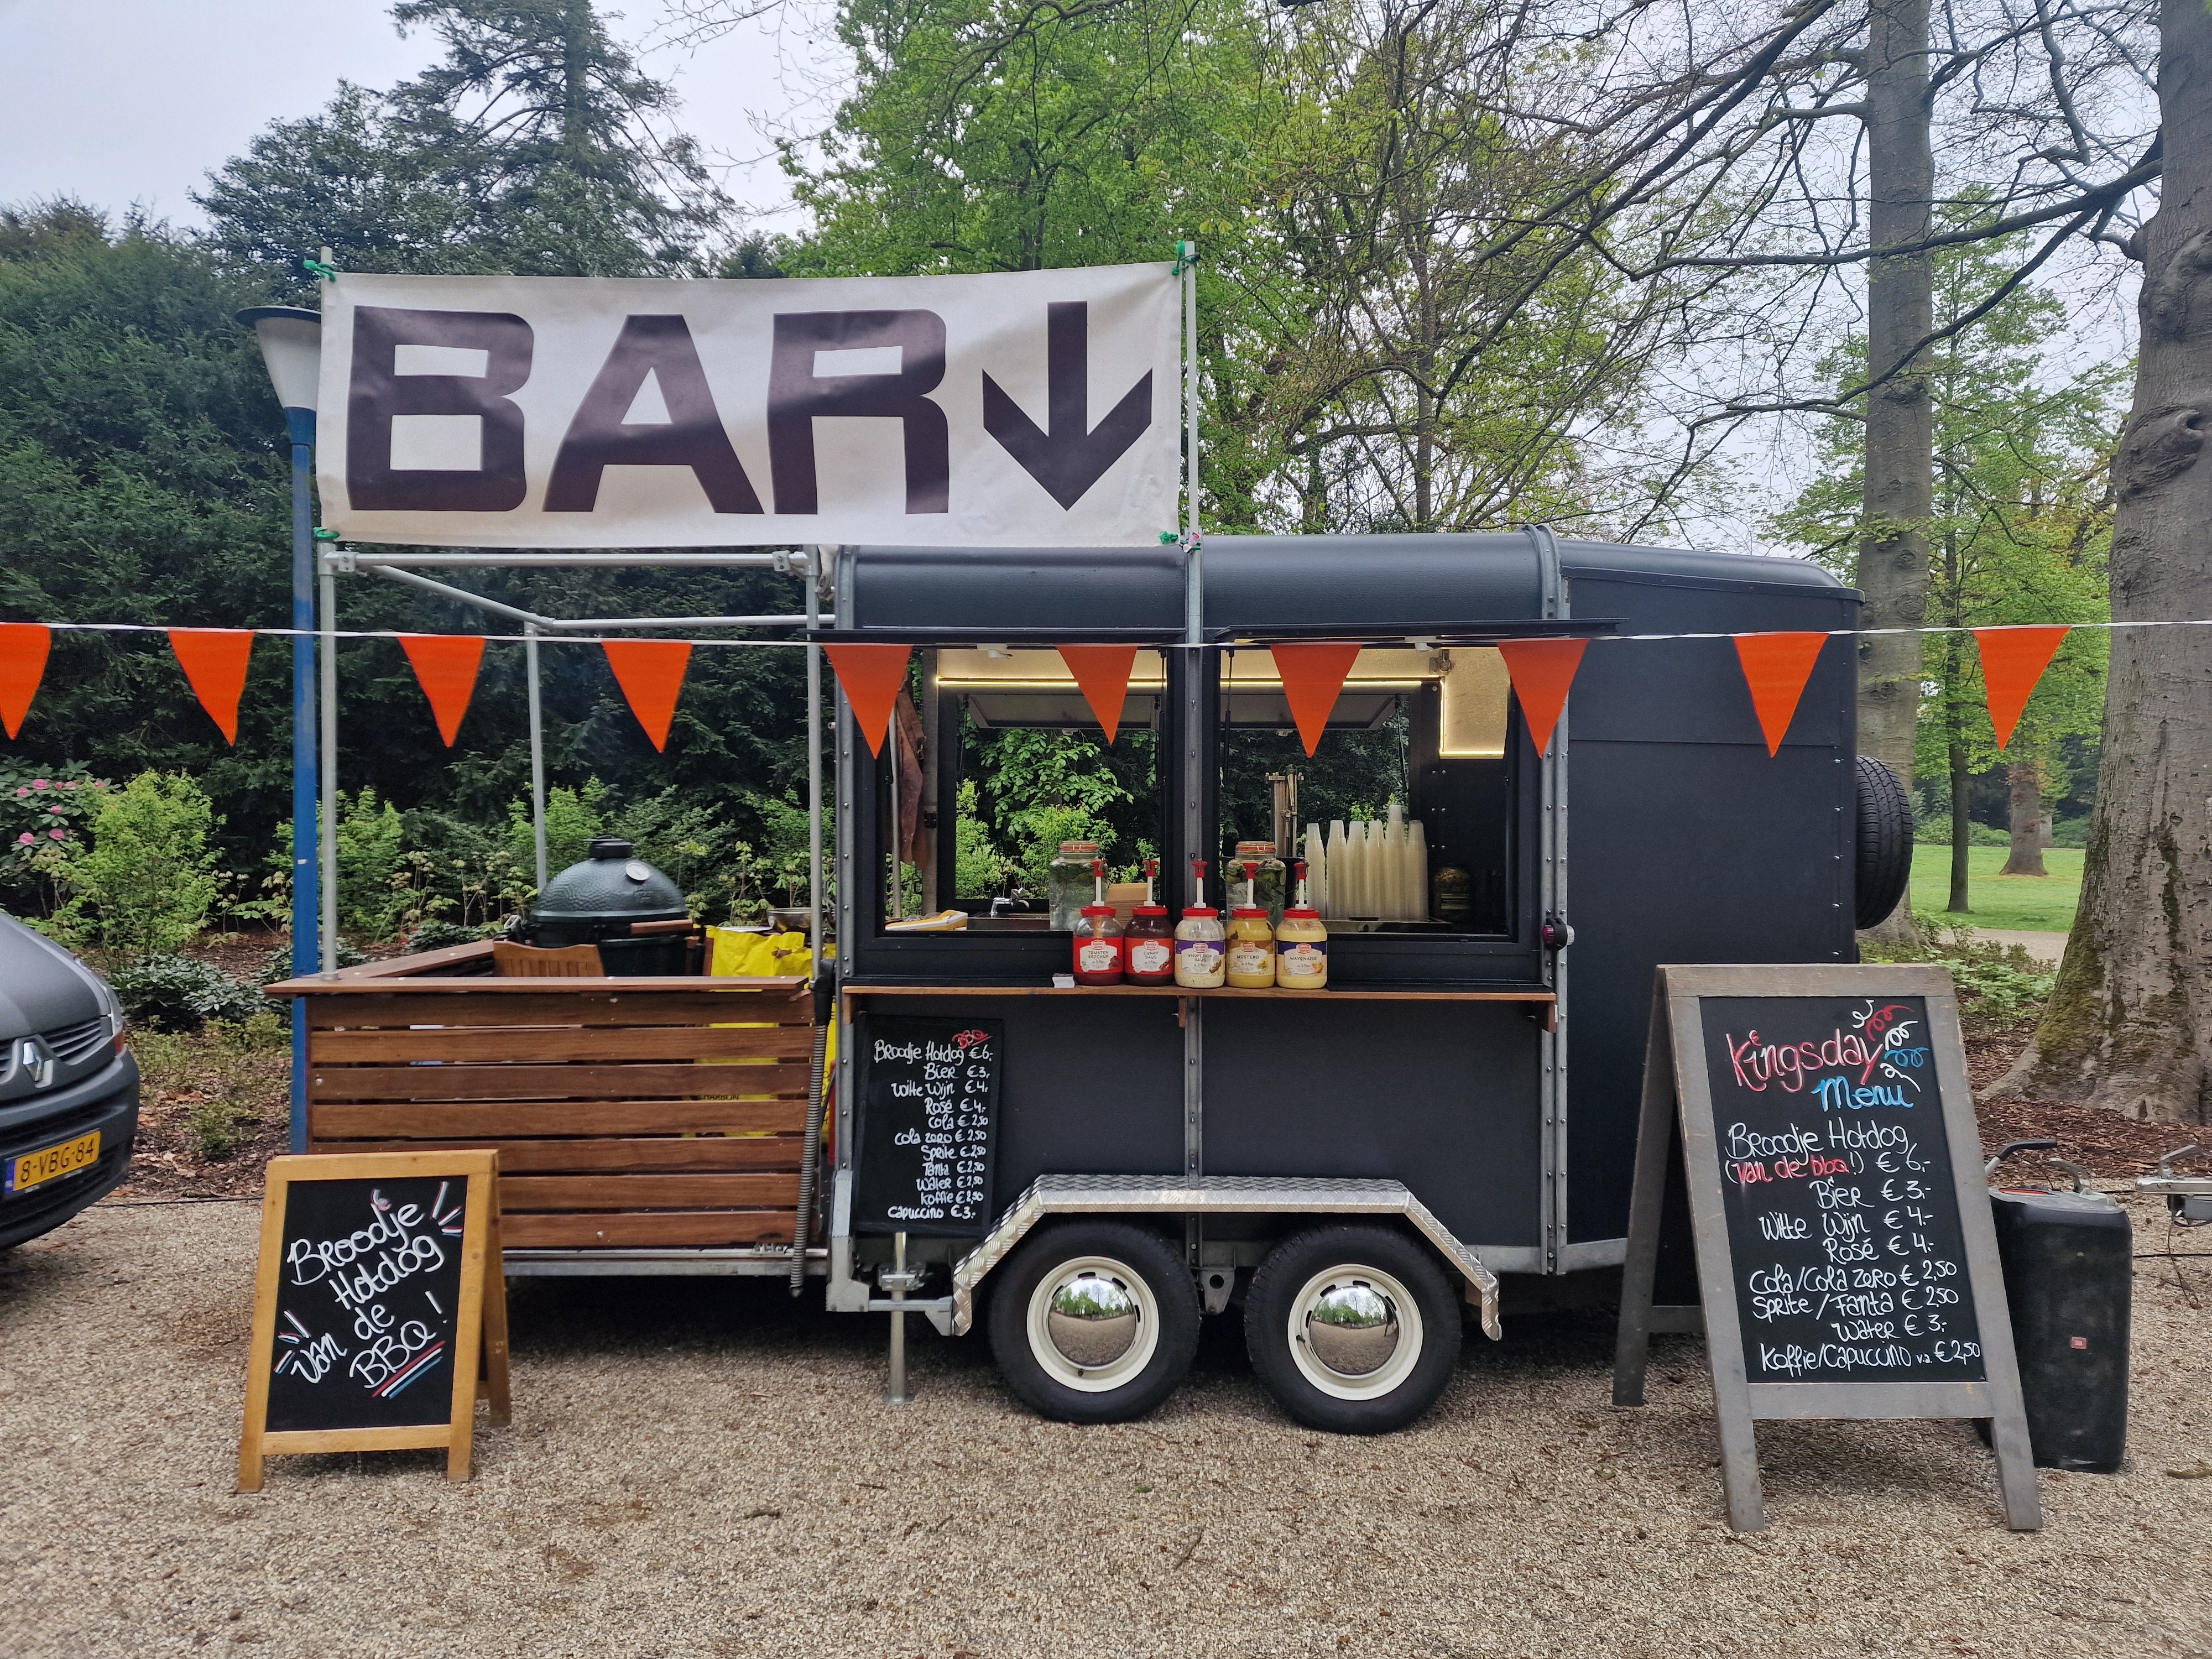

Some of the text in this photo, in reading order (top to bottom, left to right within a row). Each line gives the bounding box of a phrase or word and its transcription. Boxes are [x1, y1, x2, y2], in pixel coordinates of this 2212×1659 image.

[346, 305, 950, 515] BAR
[924, 1062, 959, 1080] Bier
[925, 1040, 964, 1066] Hotdog
[1725, 1028, 1884, 1092] Kingsday
[1811, 1076, 1914, 1112] Menu
[1828, 1117, 1908, 1154] Hotdog
[1775, 1155, 1808, 1179] de
[1809, 1176, 1875, 1209] Bier
[1759, 1211, 1813, 1240] Witte
[328, 1235, 445, 1310] Hotdog
[354, 1303, 395, 1340] de
